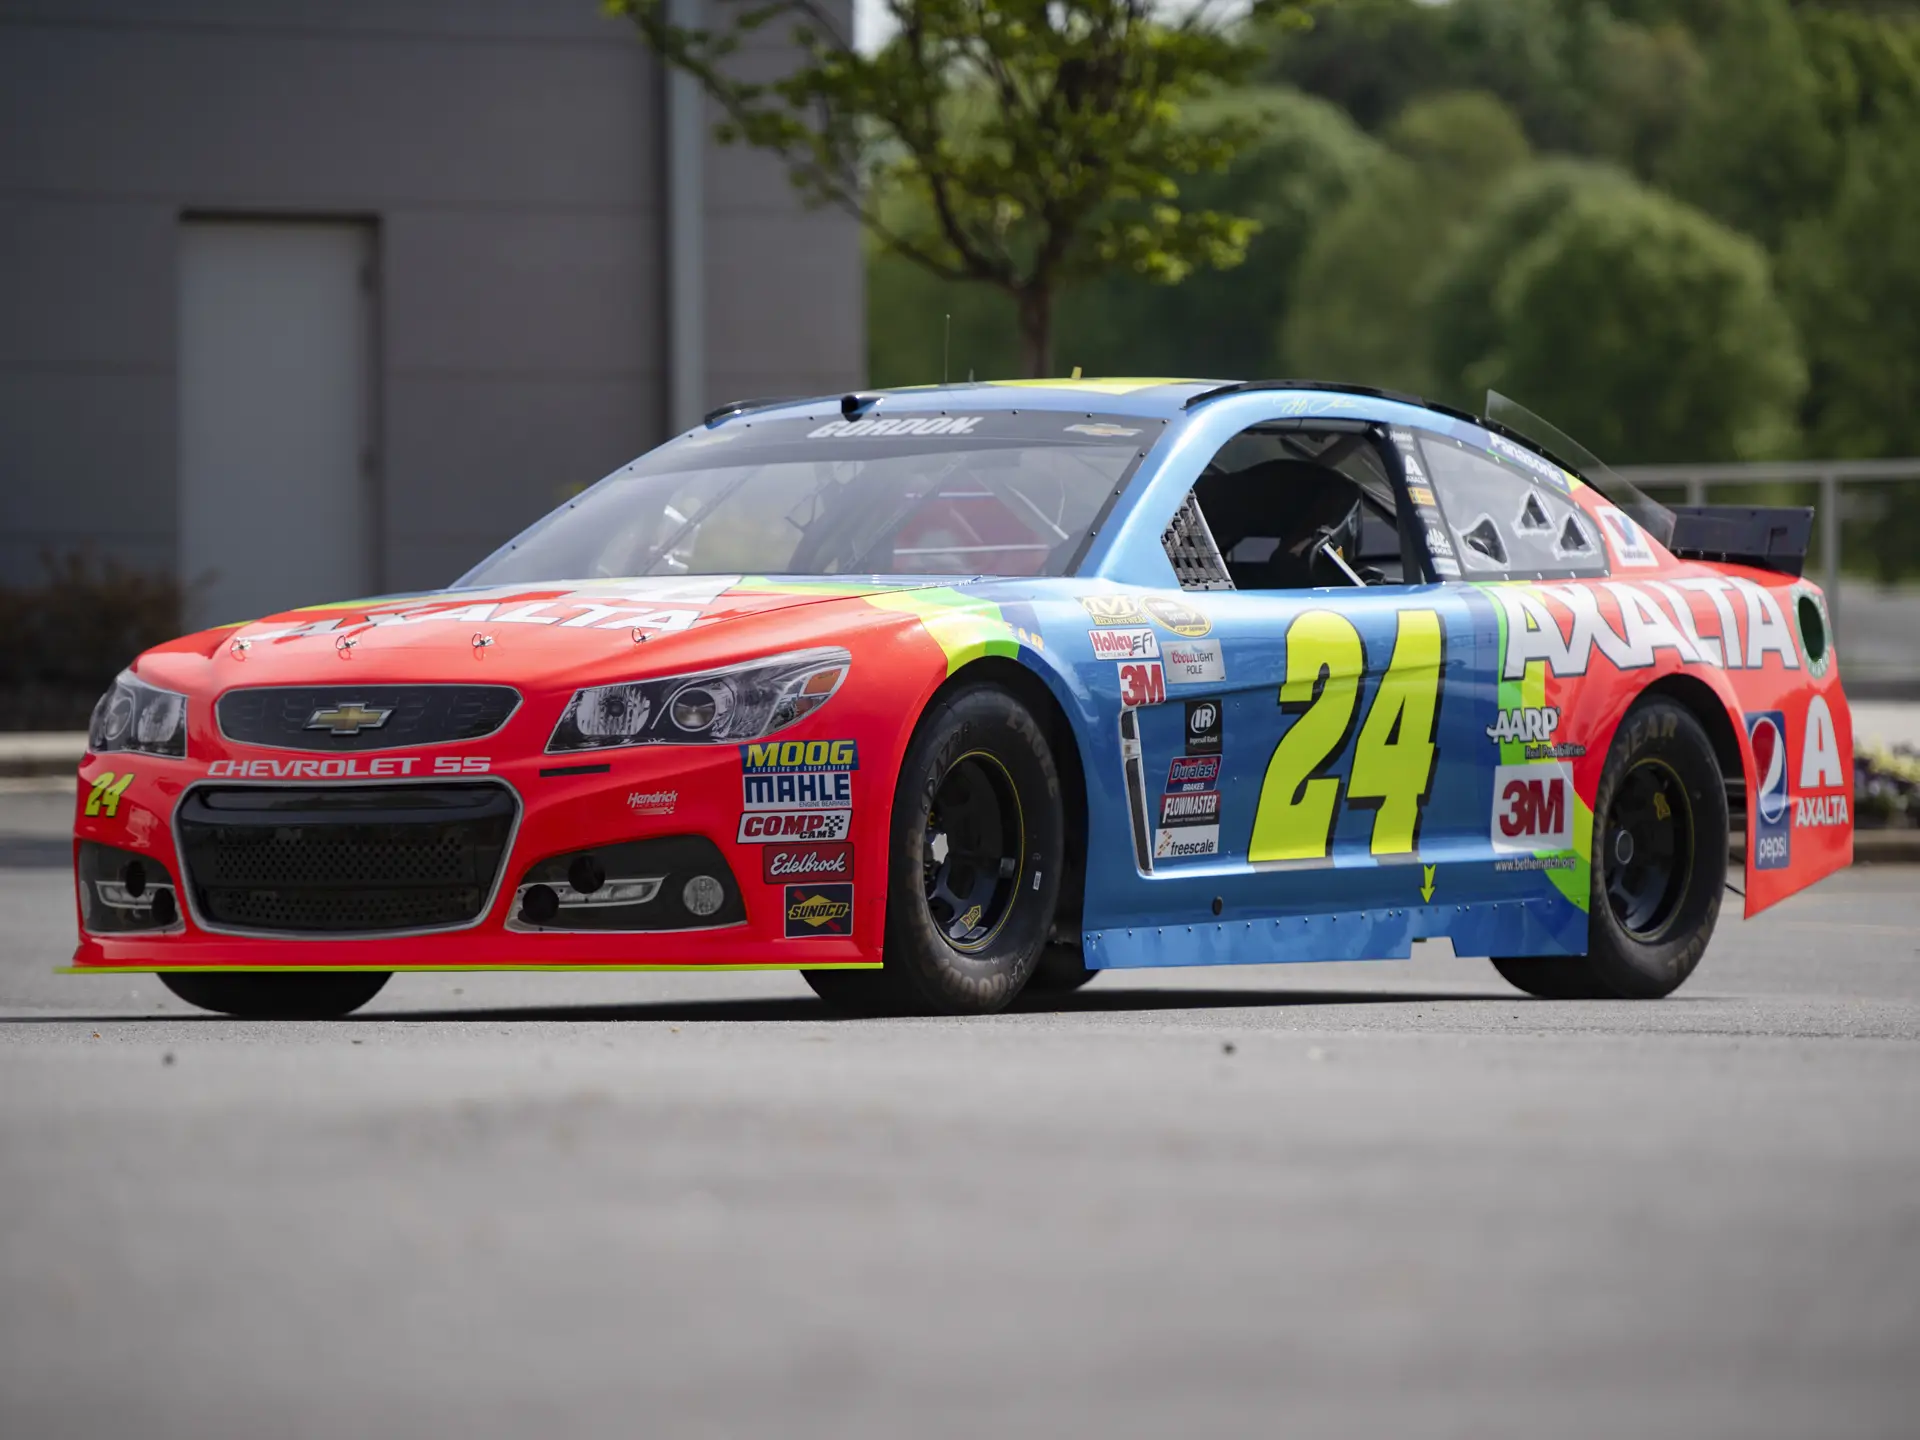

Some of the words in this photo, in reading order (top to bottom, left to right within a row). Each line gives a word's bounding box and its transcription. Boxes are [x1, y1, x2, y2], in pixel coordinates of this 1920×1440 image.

[1491, 575, 1801, 681] AXALTA
[1186, 664, 1203, 675] POLE
[1120, 664, 1165, 707] 3M
[1248, 608, 1444, 863] 24
[1485, 706, 1558, 743] AARP
[745, 740, 854, 768] MOOG
[1800, 694, 1845, 788] A
[207, 757, 420, 777] CHEVROLET
[433, 756, 492, 774] SS
[1171, 760, 1218, 781] Duralast
[84, 772, 134, 818] 24
[627, 789, 679, 809] Hendrick
[745, 773, 851, 804] MAHLE
[1182, 782, 1205, 792] BRAKES
[821, 800, 851, 808] BEARINGS
[1162, 794, 1217, 824] FLOWMASTER
[1499, 778, 1565, 837] 3M
[1795, 795, 1849, 827] AXALTA
[743, 814, 824, 838] COMP
[799, 829, 836, 839] CAMS
[1171, 838, 1214, 856] freescale
[1758, 832, 1787, 865] pepsi
[770, 852, 847, 875] Edelbrock
[1495, 856, 1576, 872] www.bethematch.org
[789, 903, 848, 920] SUNOCO
